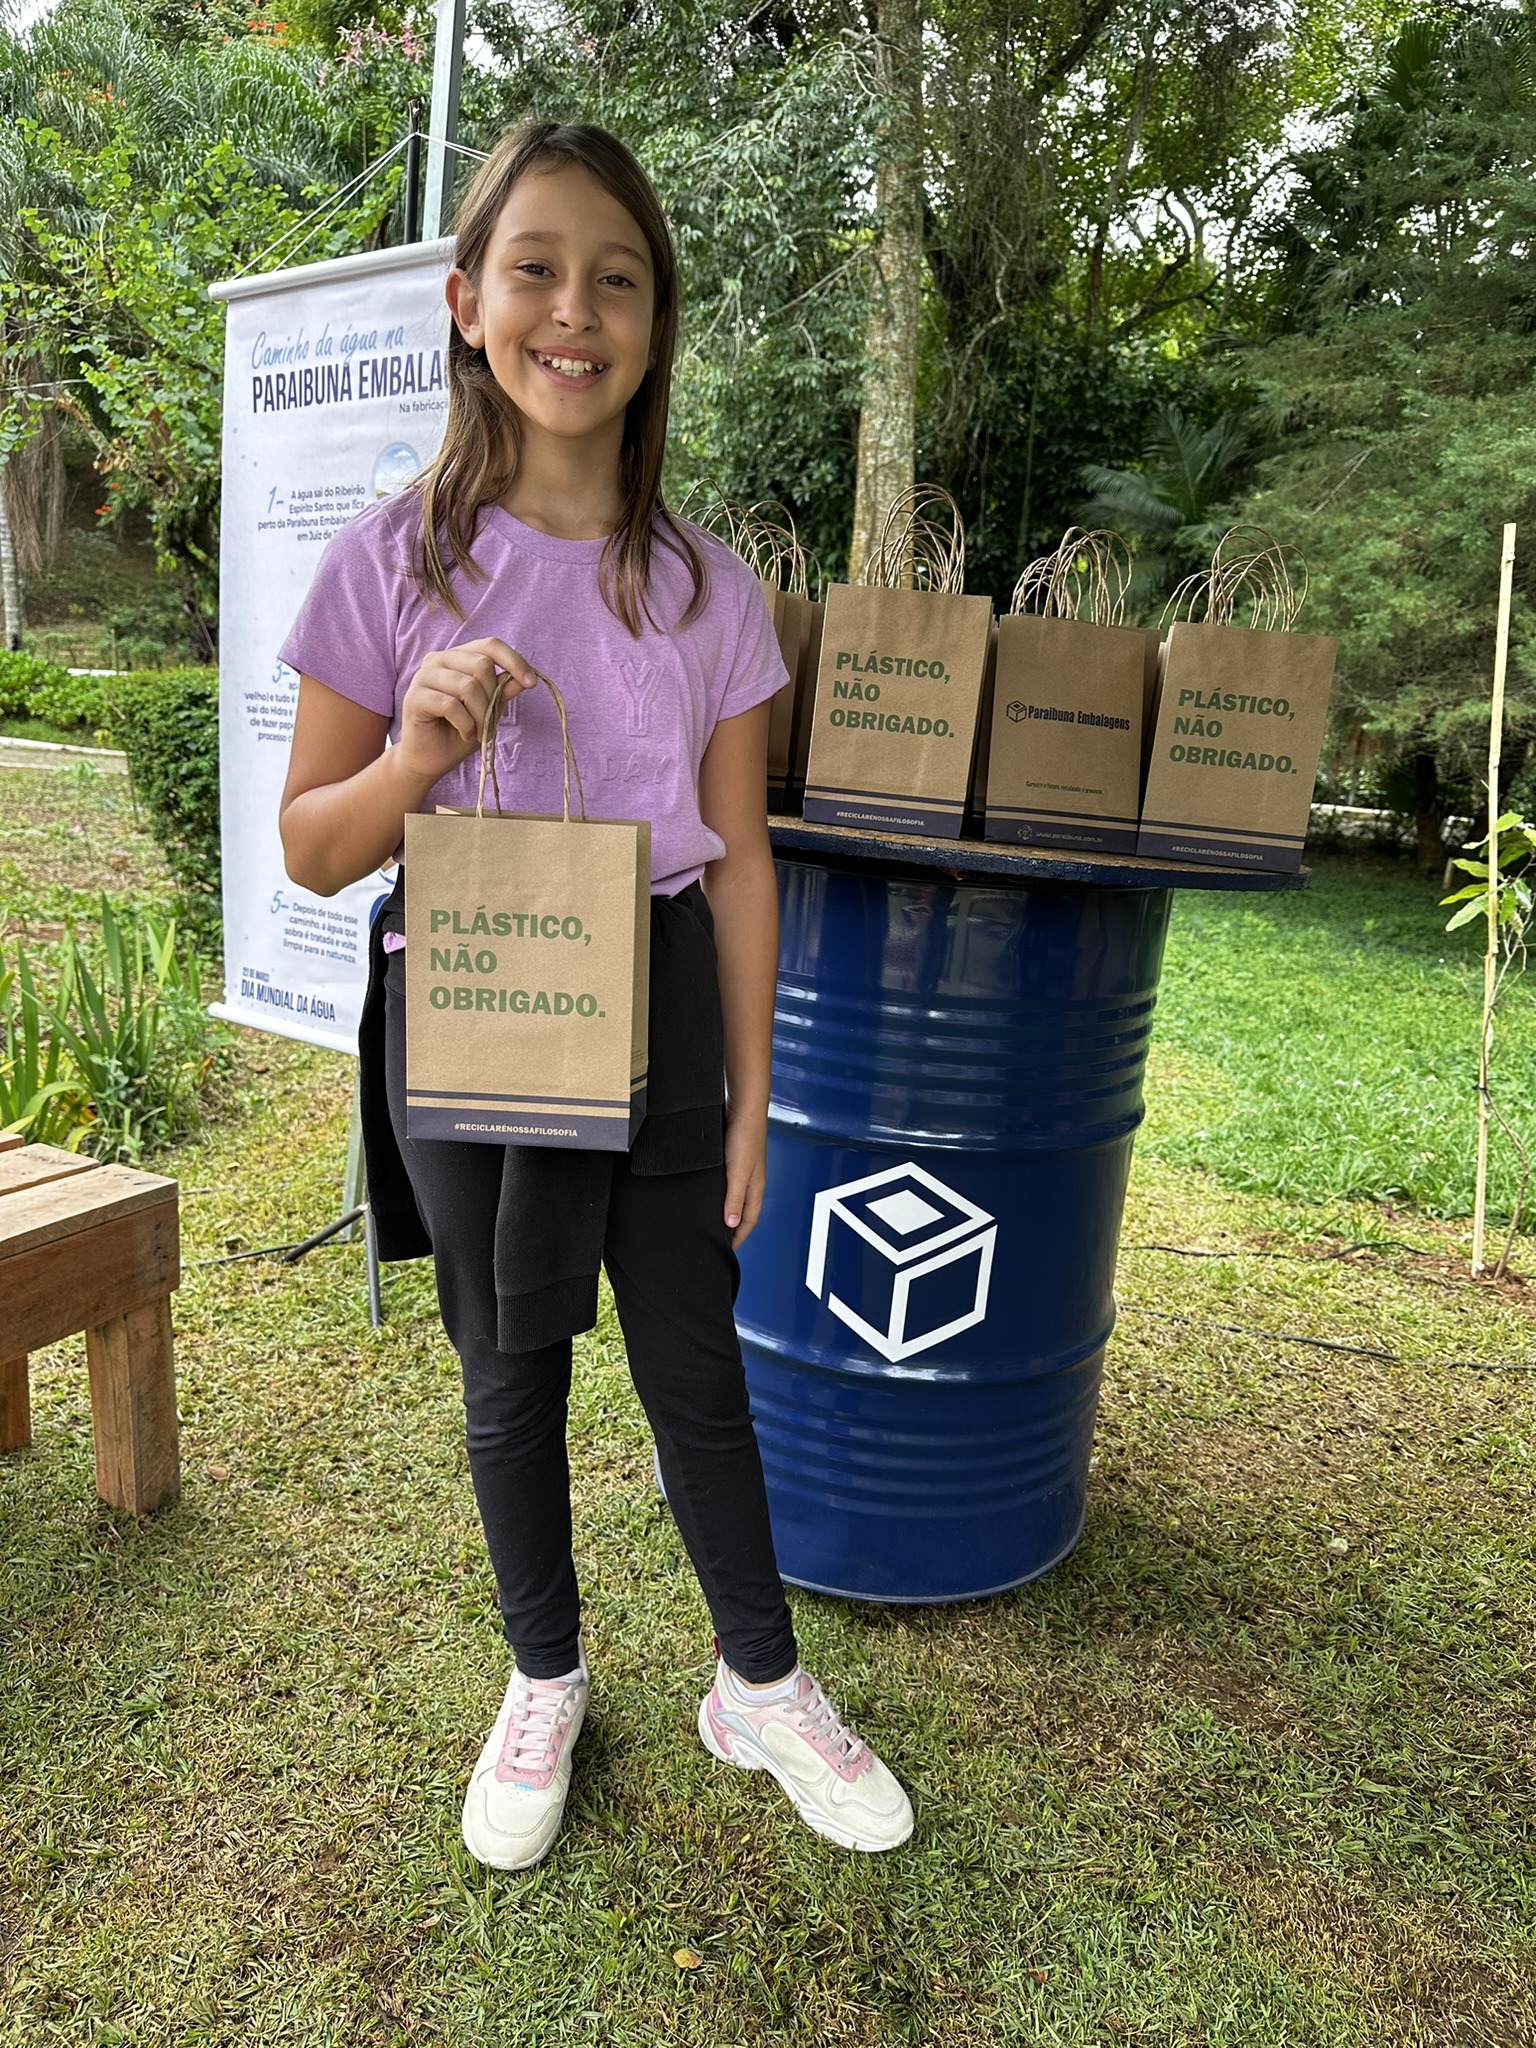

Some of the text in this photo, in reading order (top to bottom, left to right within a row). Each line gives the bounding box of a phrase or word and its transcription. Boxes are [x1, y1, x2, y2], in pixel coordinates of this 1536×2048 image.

[252, 323, 404, 369] Caminho da água na
[253, 363, 352, 413] PARAIBUNA
[400, 402, 410, 413] Na
[291, 484, 366, 501] A água sai do Ribeirão
[336, 502, 351, 514] que
[352, 499, 365, 510] fica
[258, 520, 276, 531] perto
[277, 519, 286, 529] da
[287, 517, 318, 529] Paraibuna
[297, 533, 308, 542] em
[309, 530, 322, 541] Juiz
[323, 530, 332, 540] de
[836, 650, 950, 684] PLÁSTICO,
[275, 693, 290, 703] tudo
[833, 678, 880, 701] NÃO
[247, 704, 258, 713] sai
[260, 706, 269, 714] do
[1178, 687, 1295, 721] PLÁSTICO,
[250, 717, 261, 726] de
[262, 718, 278, 728] fazer
[830, 709, 954, 738] OBRIGADO.
[1028, 705, 1130, 730] Paraibuna Embalagens
[1173, 714, 1223, 738] NÃO
[1169, 744, 1297, 774] OBRIGADO.
[836, 811, 925, 826] #RECICLARÉNOSSAFILOSOFIA
[1172, 846, 1263, 861] #RECICLARÉNOSSAFILOSOFIA
[293, 902, 358, 925] Depois de todo esse
[327, 923, 343, 936] água
[345, 928, 358, 939] que
[430, 905, 592, 947] PLÁSTICO,
[283, 938, 303, 952] limpa
[304, 944, 319, 957] para
[284, 927, 303, 939] sobra
[310, 932, 335, 946] tratada
[341, 940, 357, 951] volta
[430, 943, 497, 974] NÃO
[241, 979, 336, 1022] DIA MUNDIAL DA ÁGUA
[429, 986, 606, 1018] OBRIGADO.
[454, 1122, 578, 1137] #RECICLARÉNOSSAFILOSOFIA
